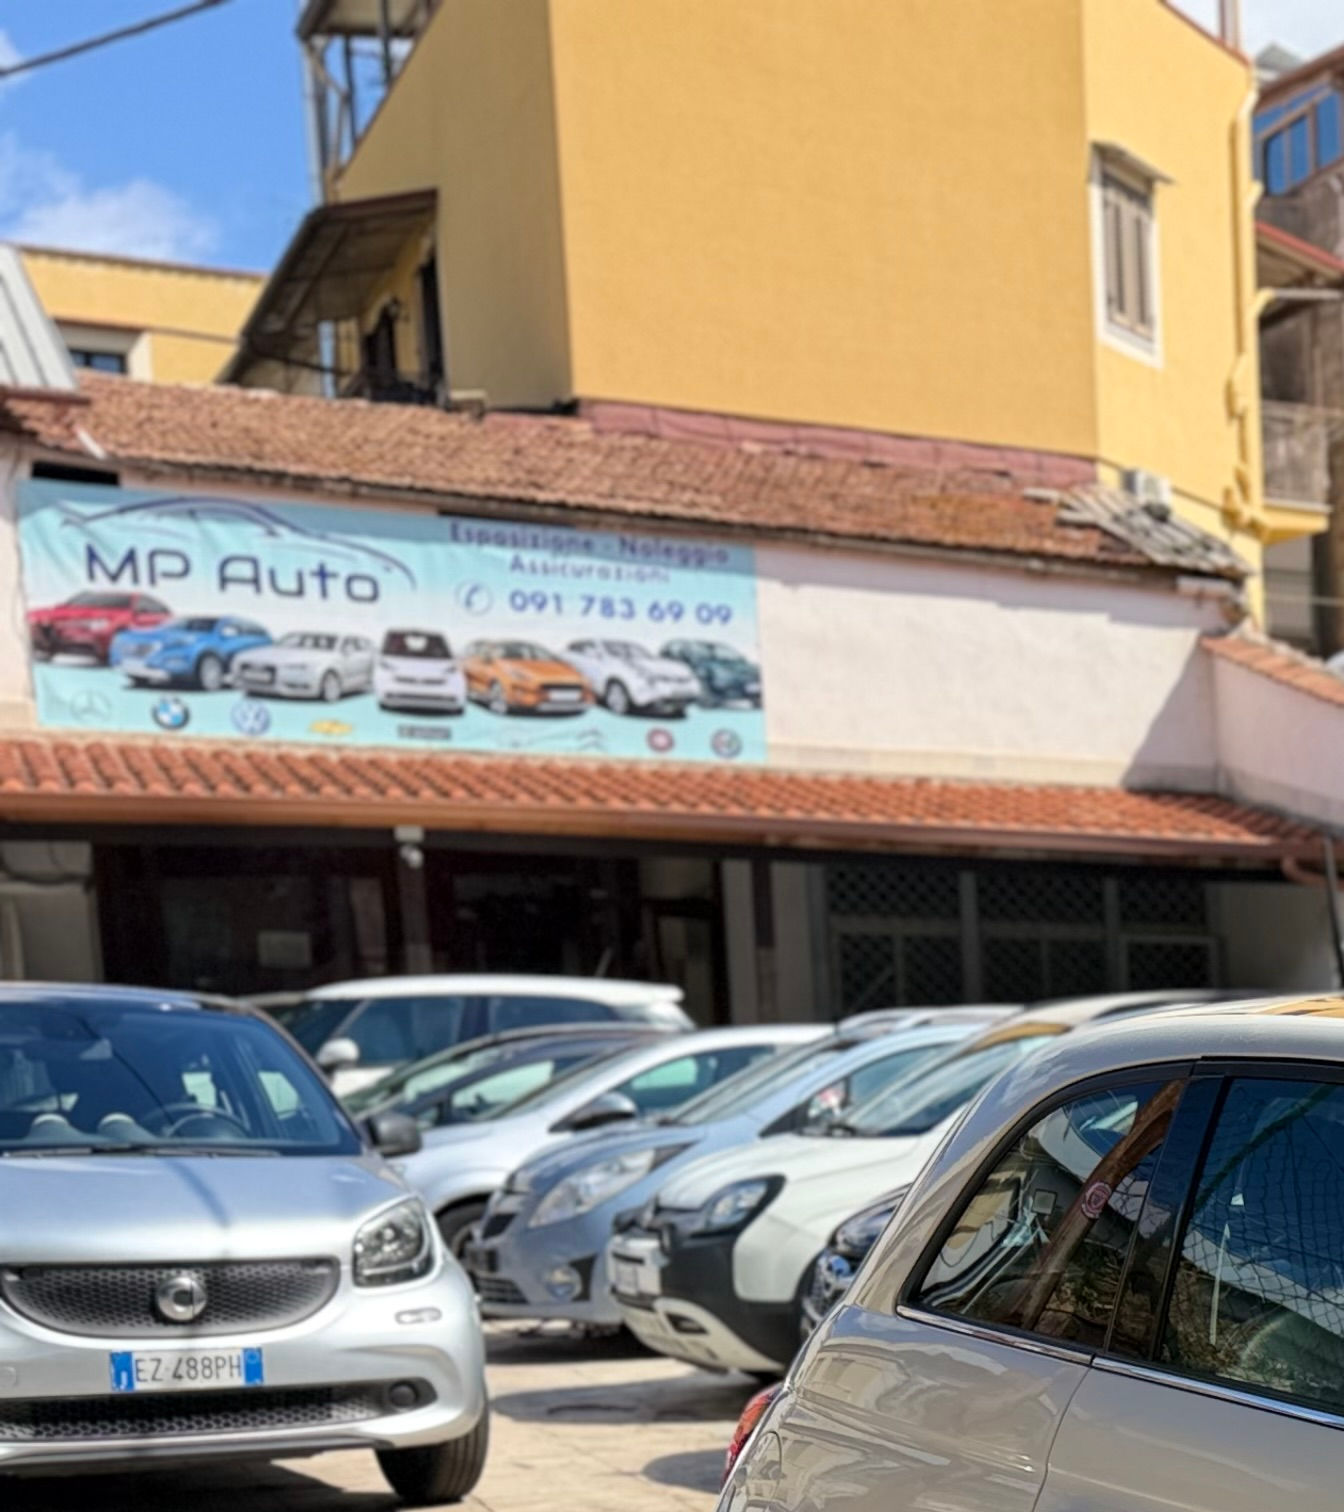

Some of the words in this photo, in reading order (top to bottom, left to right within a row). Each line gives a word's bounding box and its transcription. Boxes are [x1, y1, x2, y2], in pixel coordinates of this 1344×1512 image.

[618, 536, 730, 567] Noleggio
[85, 543, 191, 587] MP
[217, 554, 381, 604] Auto
[508, 588, 563, 615] 091
[578, 593, 637, 620] 783
[647, 599, 686, 623] 69
[695, 602, 735, 626] 09
